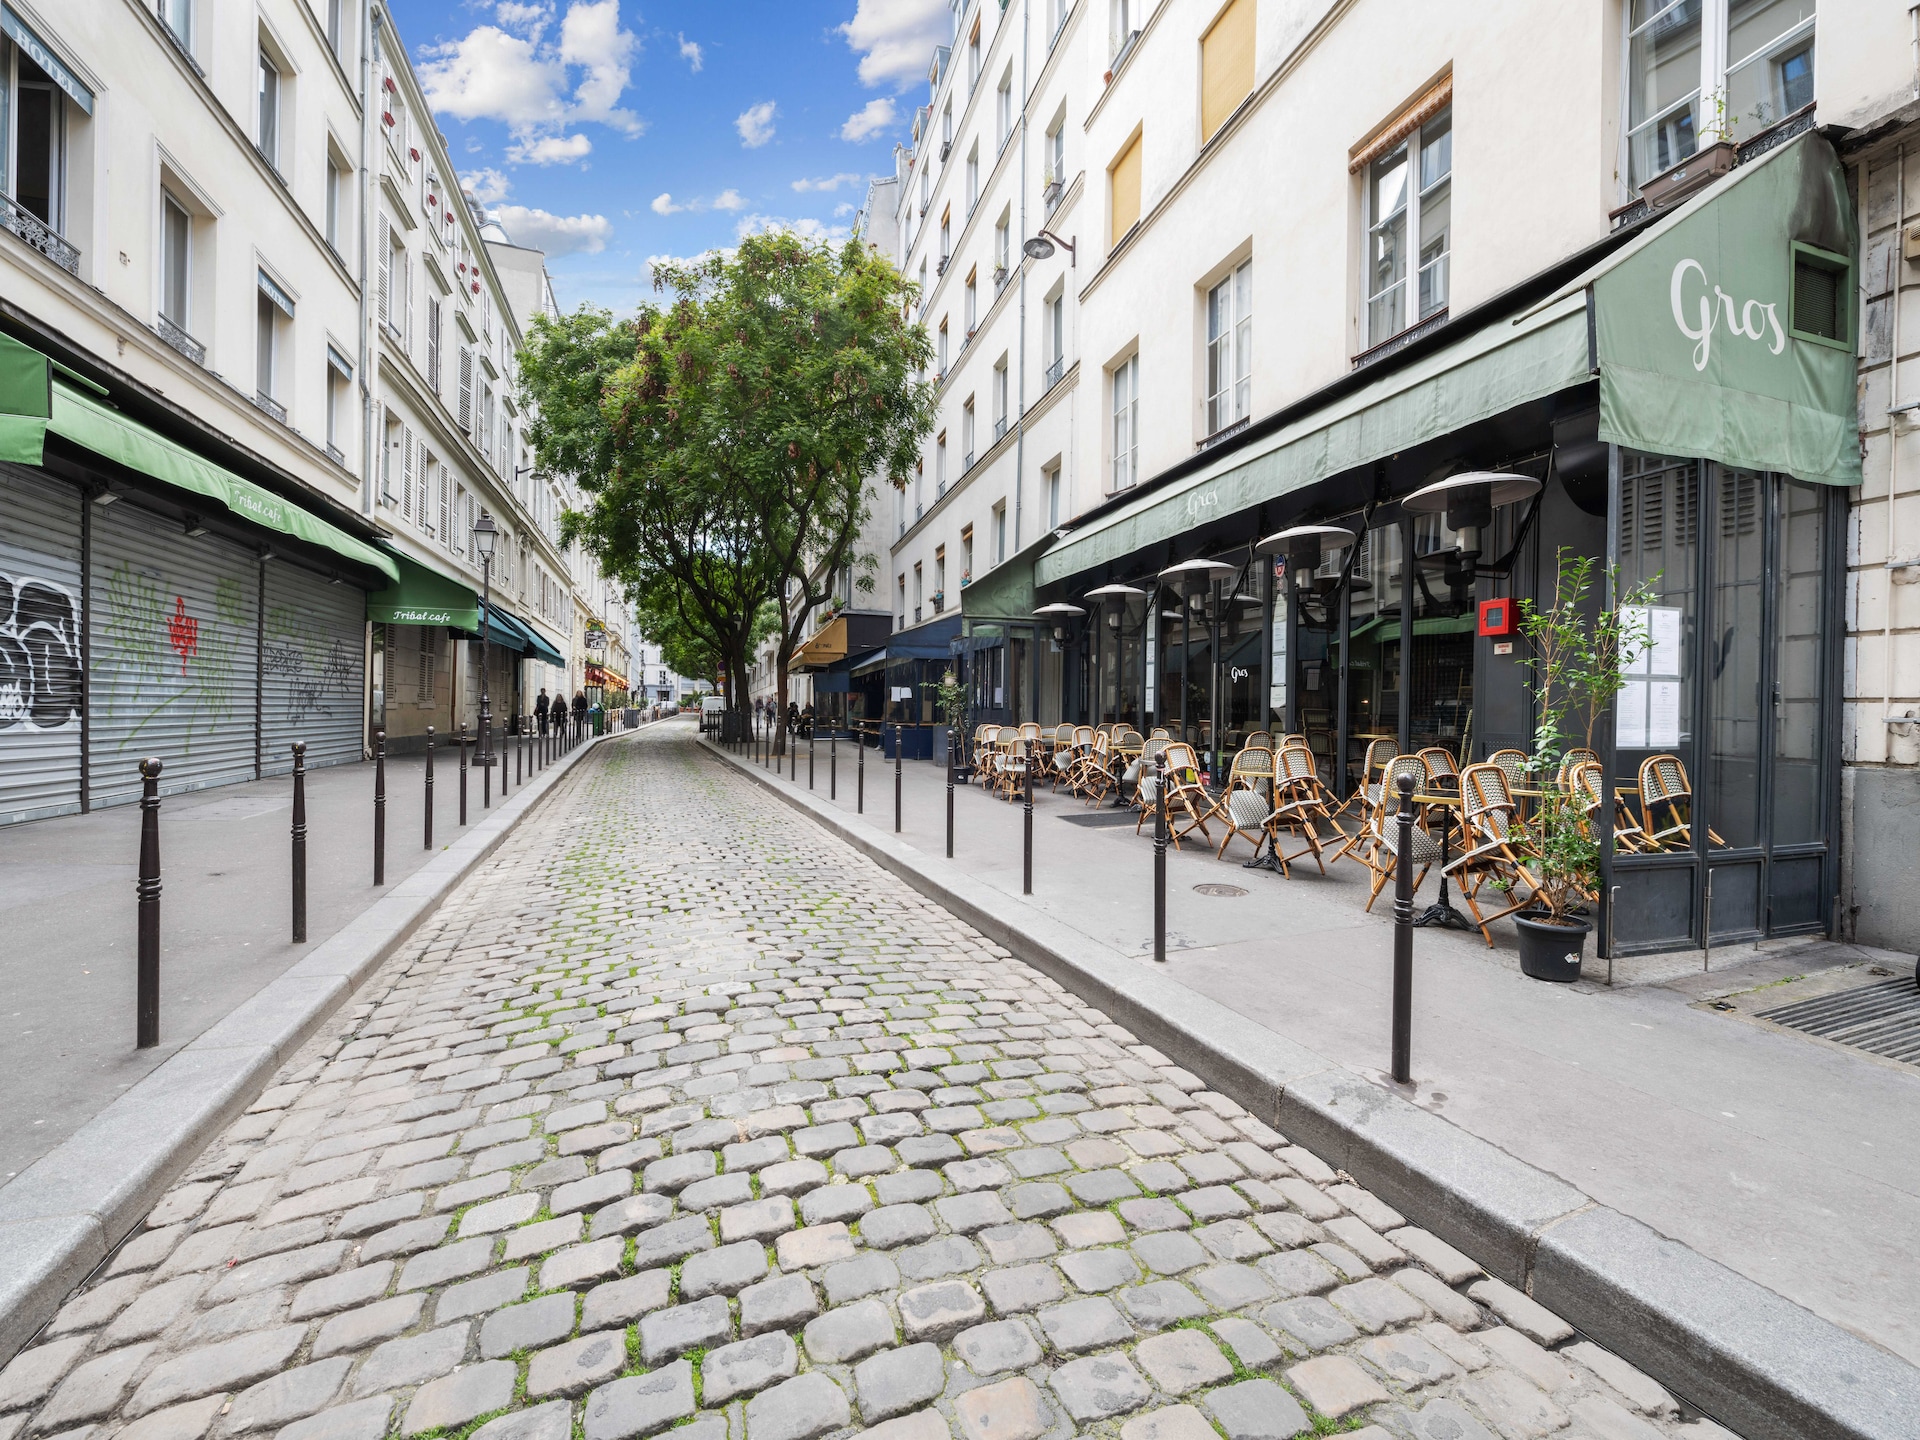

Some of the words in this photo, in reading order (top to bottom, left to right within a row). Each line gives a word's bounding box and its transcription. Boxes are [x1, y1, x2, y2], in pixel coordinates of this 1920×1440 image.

[13, 25, 79, 100] HOTEL
[261, 277, 288, 311] HOTEL
[1669, 257, 1786, 372] Gros
[233, 490, 262, 513] Tribal
[1187, 492, 1218, 523] Gros
[393, 611, 428, 620] Tribal
[1230, 666, 1249, 684] Gros
